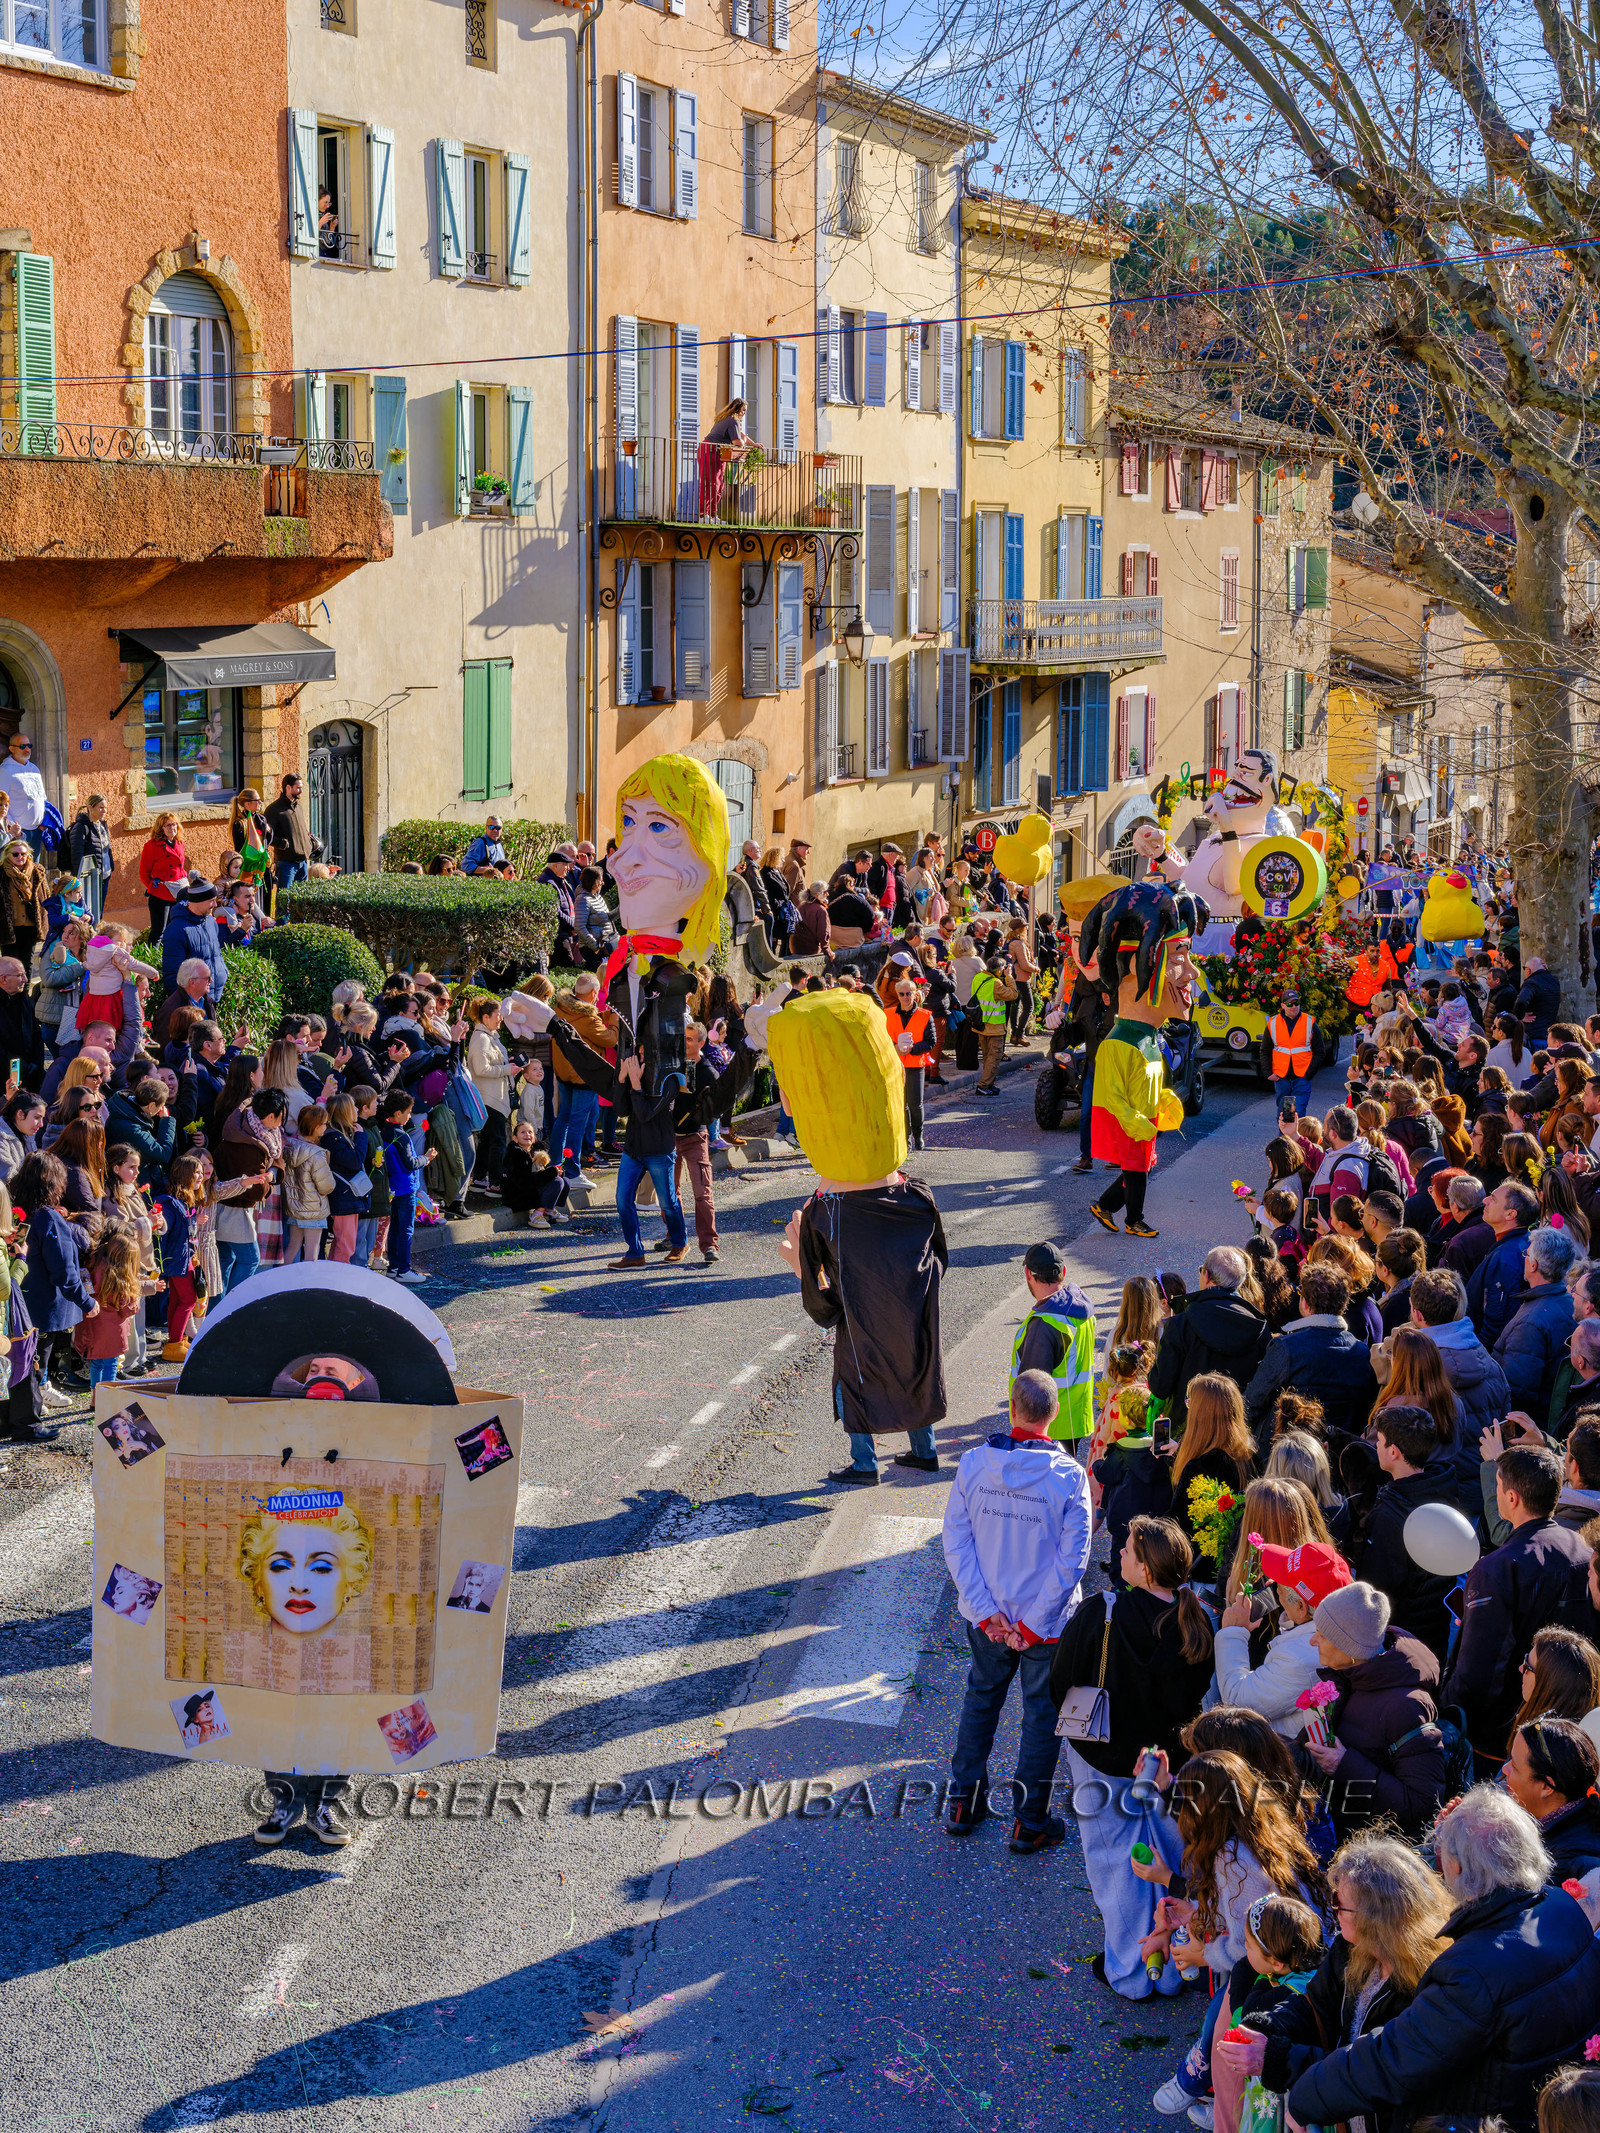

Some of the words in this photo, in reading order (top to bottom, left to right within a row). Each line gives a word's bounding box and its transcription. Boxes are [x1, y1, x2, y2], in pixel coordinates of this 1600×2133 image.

[230, 662, 264, 674] MAGREY
[265, 662, 271, 672] &
[273, 660, 294, 671] SONS
[976, 823, 999, 833] BARNES
[981, 831, 993, 849] B
[1271, 901, 1282, 915] 6
[271, 1493, 341, 1510] MADONNA
[979, 1485, 1005, 1497] Réserve
[1006, 1490, 1049, 1504] Communale
[279, 1508, 336, 1520] CELEBRATION
[982, 1507, 990, 1515] de
[1020, 1514, 1042, 1524] Civile
